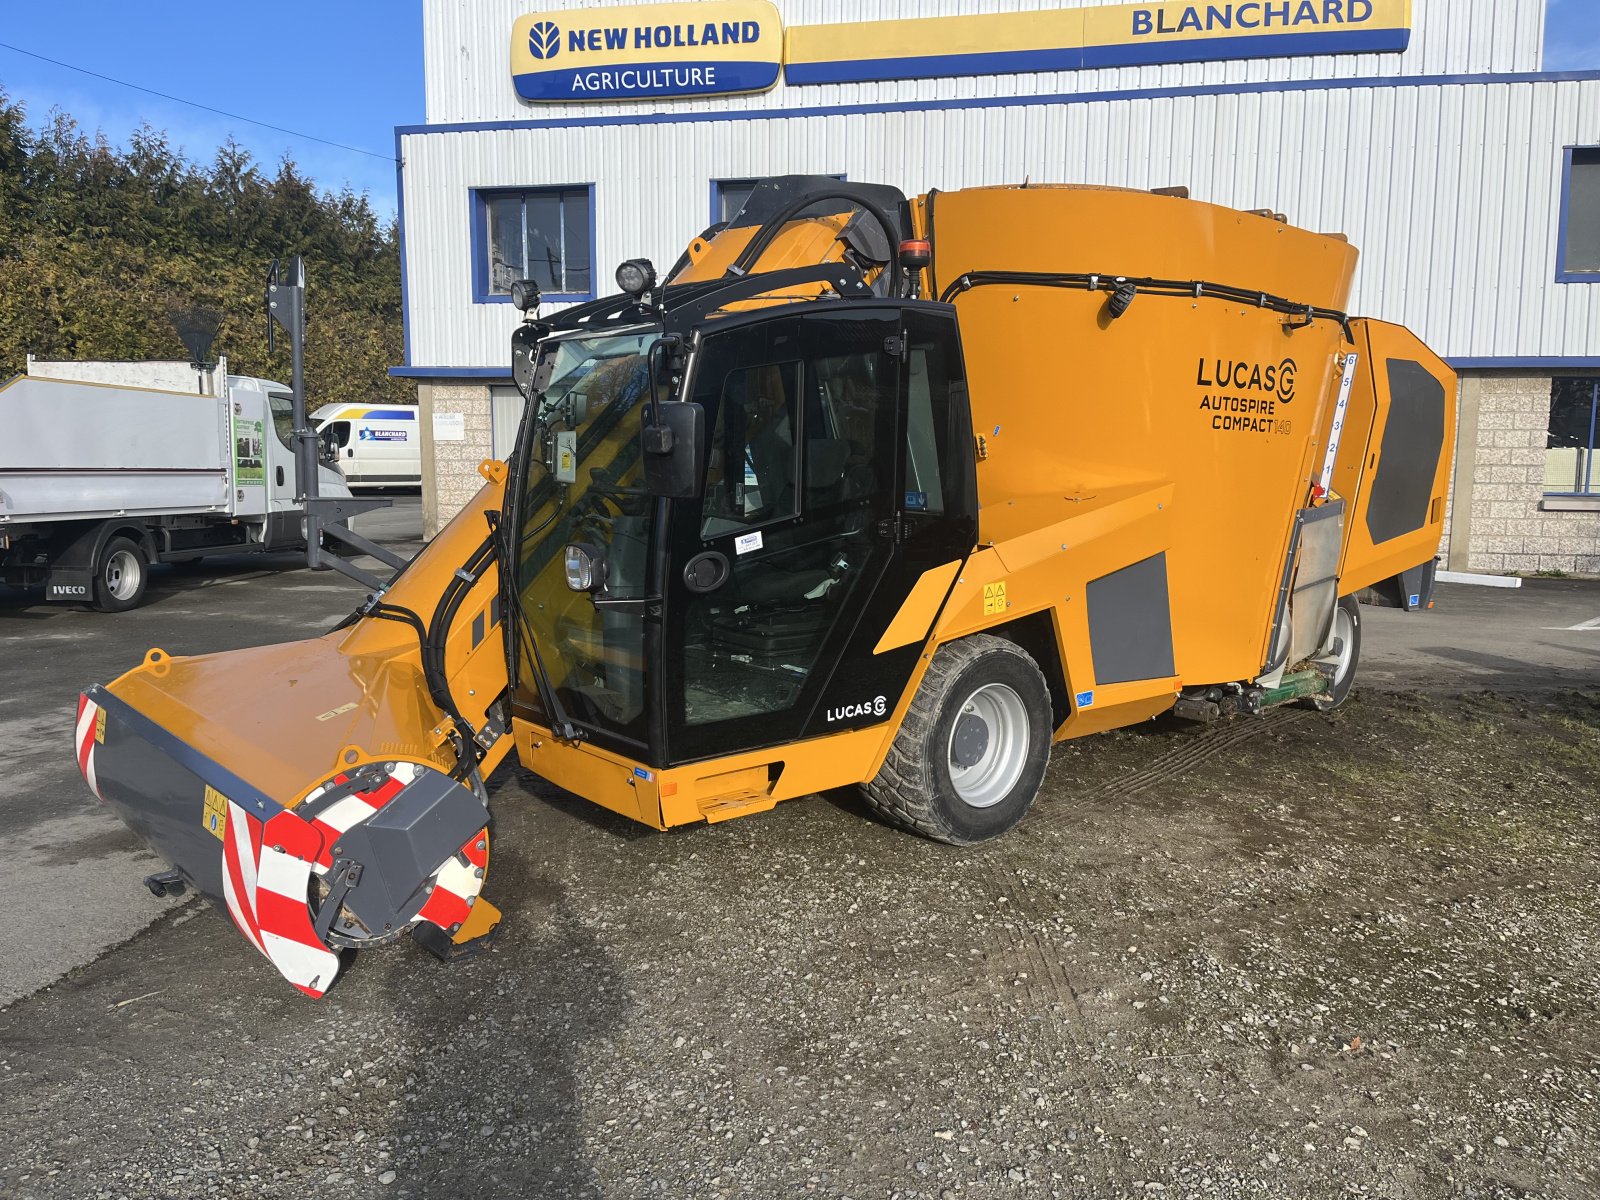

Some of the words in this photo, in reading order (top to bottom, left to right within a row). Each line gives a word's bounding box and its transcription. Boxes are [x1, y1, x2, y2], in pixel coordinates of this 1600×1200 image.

[1132, 0, 1373, 35] BLANCHARD
[568, 28, 628, 52] NEW
[634, 21, 760, 49] HOLLAND
[571, 67, 716, 92] AGRICULTURE
[1347, 356, 1354, 365] 6
[1197, 358, 1276, 392] LUCAS
[1343, 377, 1350, 387] 5
[1200, 394, 1275, 415] AUTOSPIRE
[1338, 399, 1345, 409] 4
[1333, 421, 1340, 431] 3
[1329, 443, 1336, 452] 2
[1325, 465, 1331, 474] 1
[53, 585, 86, 595] IVECO
[827, 701, 872, 722] LUCAS
